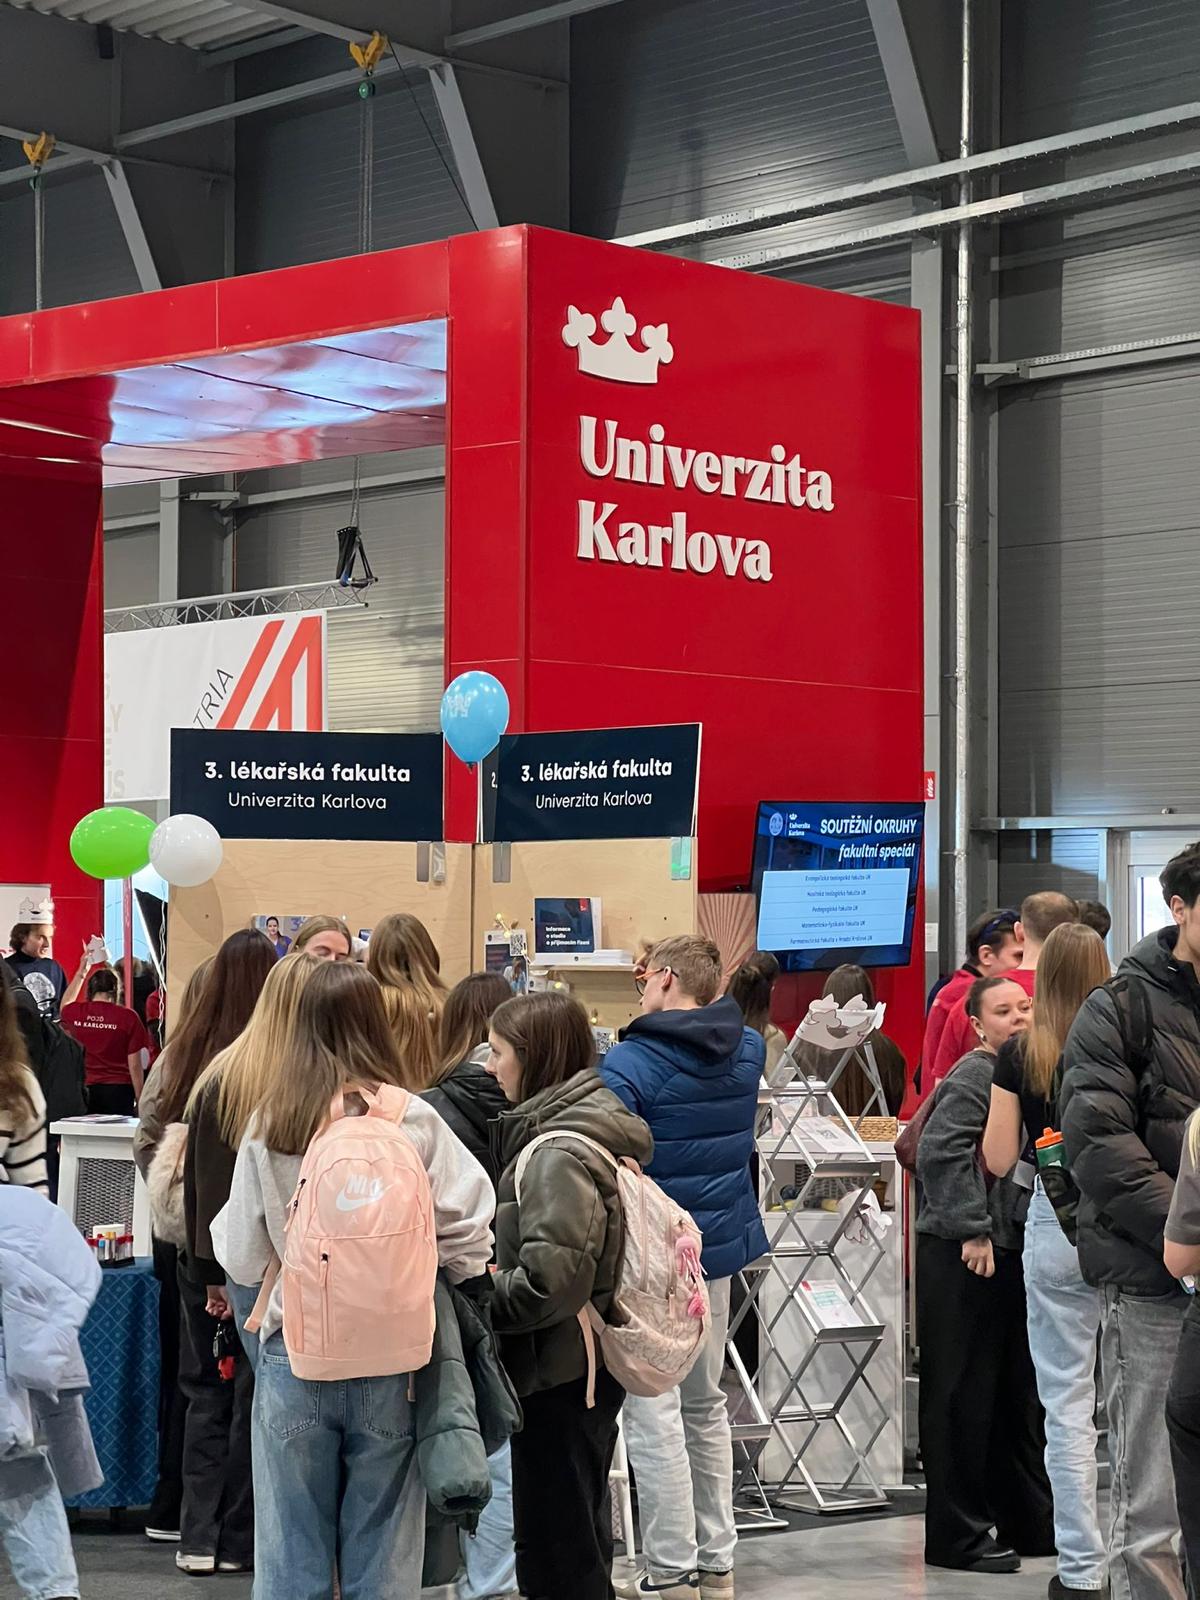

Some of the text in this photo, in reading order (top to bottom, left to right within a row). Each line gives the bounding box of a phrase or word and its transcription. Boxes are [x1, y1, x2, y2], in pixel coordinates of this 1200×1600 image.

[579, 415, 835, 512] Univerzita
[577, 499, 773, 582] Karlova
[205, 760, 411, 782] 3. lékařská fakulta
[521, 757, 673, 782] 3. lékařská fakulta
[228, 792, 387, 809] Univerzita Karlova
[535, 790, 652, 809] Univerzita Karlova
[820, 814, 917, 834] SOUTĚŽNÍ OKRUHY
[838, 843, 916, 862] fakultní speciál
